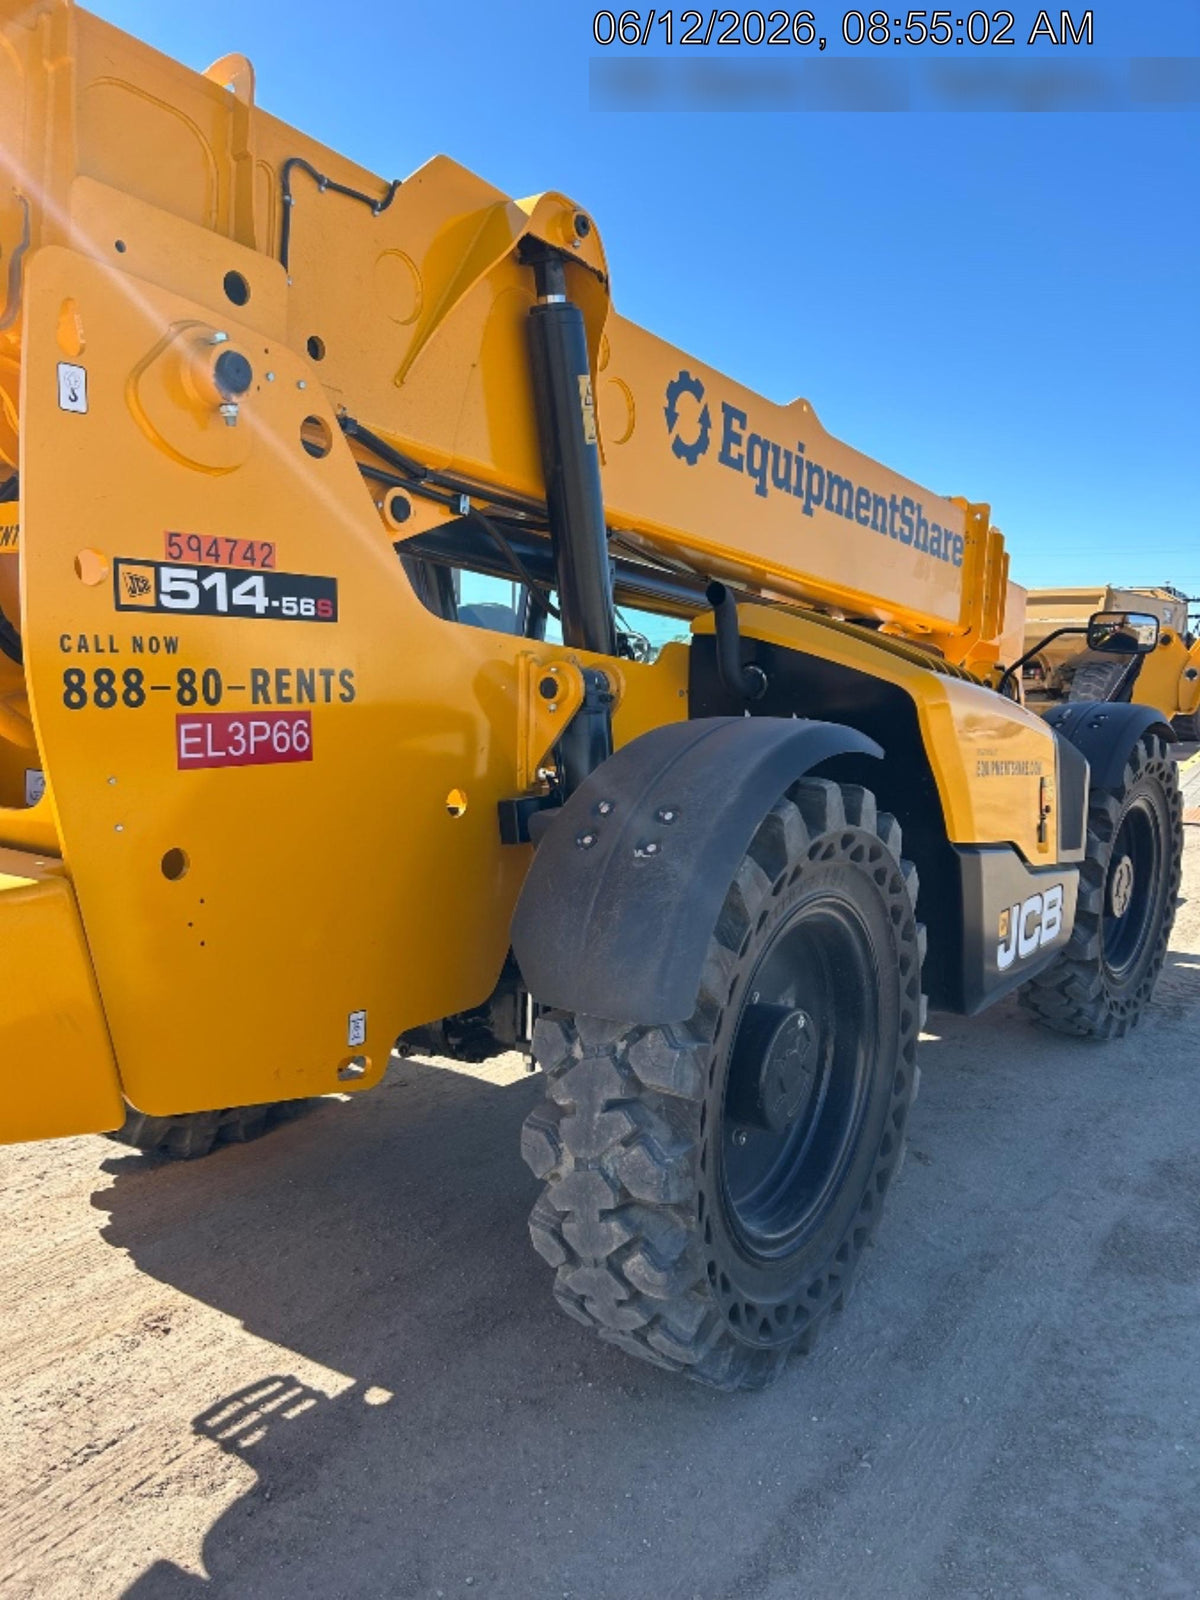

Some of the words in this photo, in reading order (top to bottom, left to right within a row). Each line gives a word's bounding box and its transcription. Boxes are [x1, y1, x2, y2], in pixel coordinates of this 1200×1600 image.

[717, 401, 964, 568] EquipmentShare
[167, 532, 274, 569] 594742
[59, 633, 119, 654] CALL
[131, 635, 179, 655] NOW
[62, 667, 356, 710] 888-80-RENTS
[179, 719, 311, 759] EL3P66
[996, 883, 1064, 972] JCB
